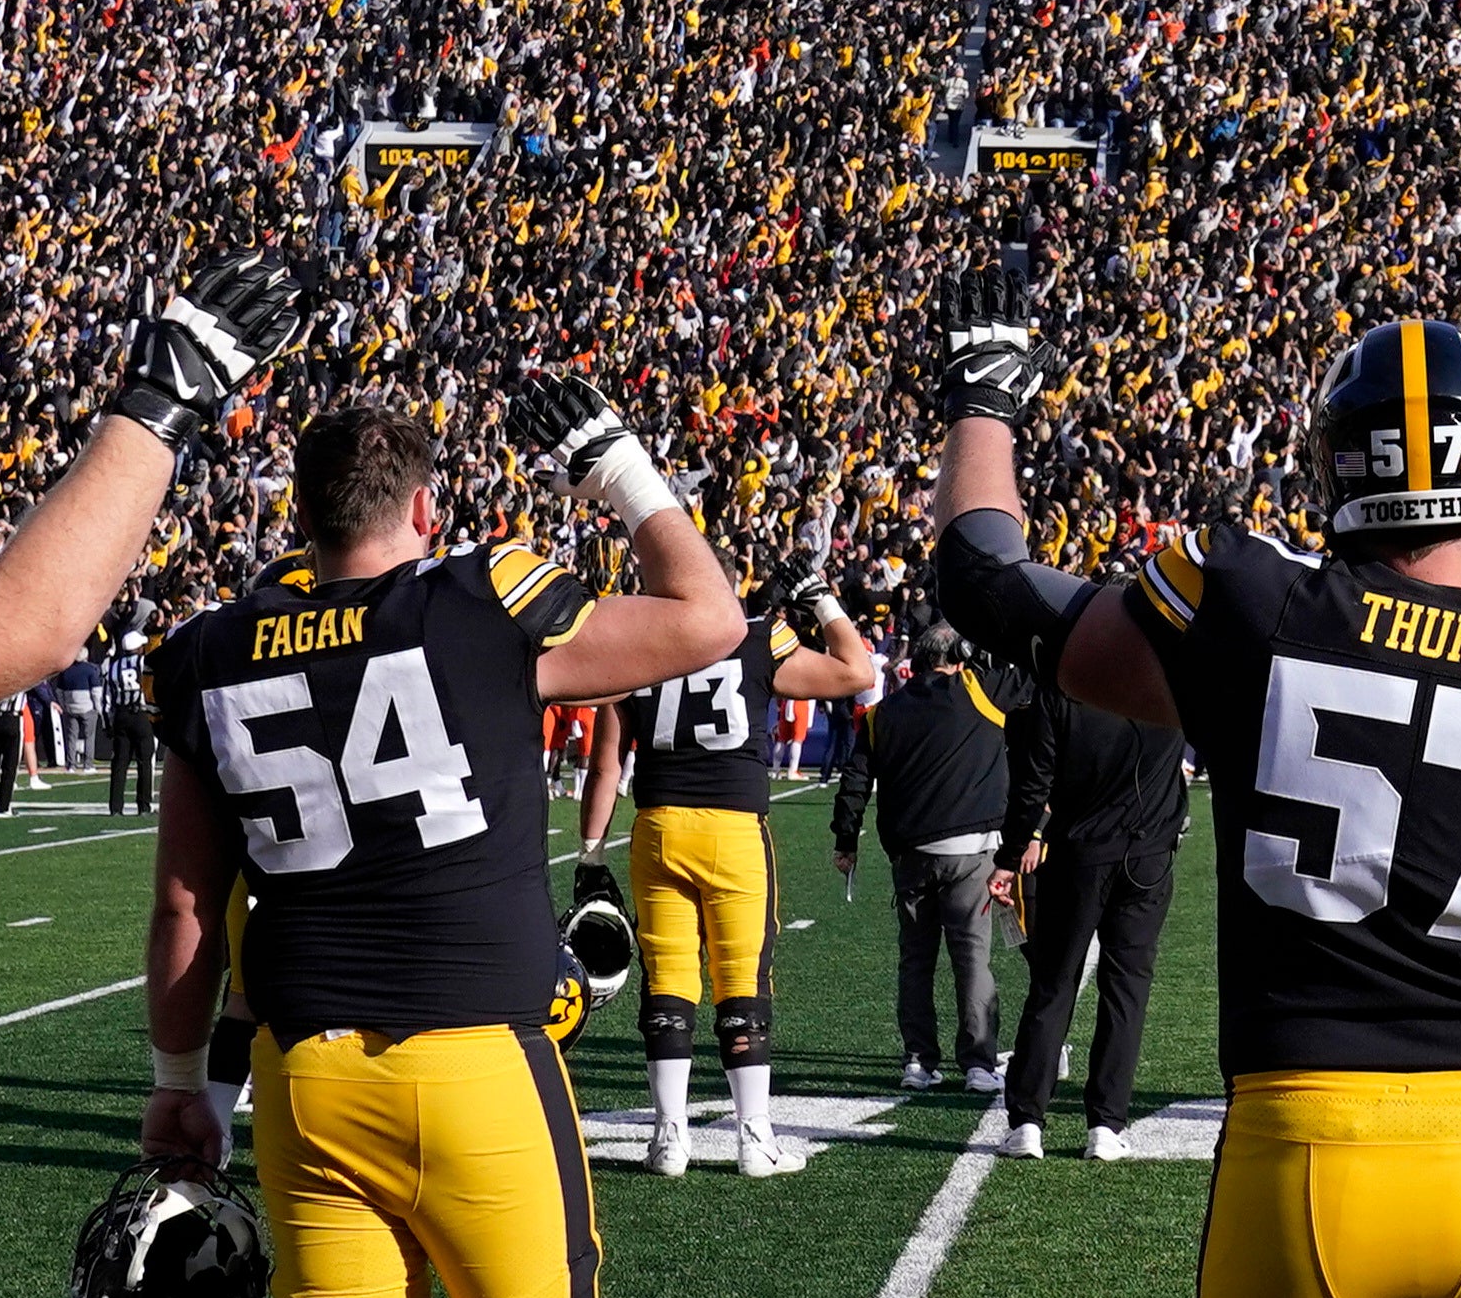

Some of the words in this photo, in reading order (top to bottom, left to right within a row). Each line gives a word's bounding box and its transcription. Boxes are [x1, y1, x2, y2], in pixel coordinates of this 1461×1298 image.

[993, 152, 1028, 169] 104
[1049, 152, 1085, 169] 105
[252, 606, 368, 662] FAGAN
[122, 669, 140, 692] R
[201, 646, 488, 874] 54
